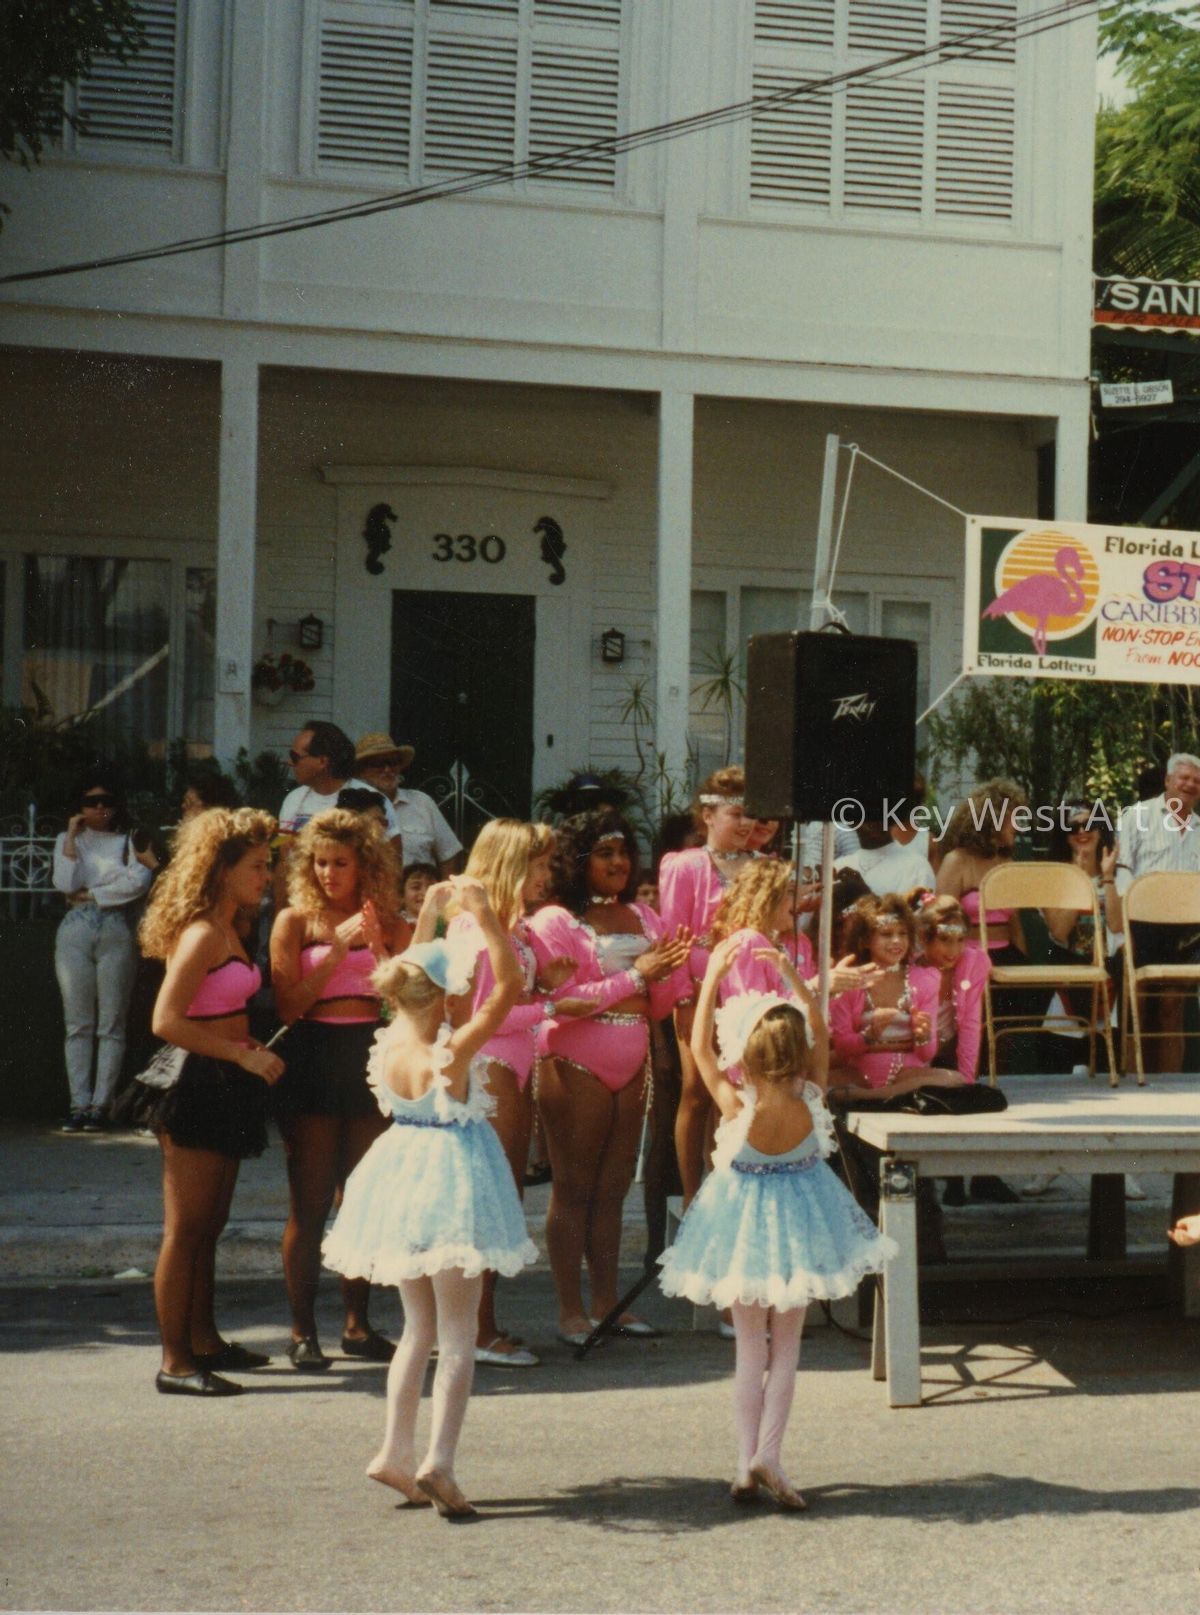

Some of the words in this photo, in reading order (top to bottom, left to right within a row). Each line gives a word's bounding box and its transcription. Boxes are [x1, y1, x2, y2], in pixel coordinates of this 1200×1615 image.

[432, 533, 507, 564] 330
[1104, 535, 1184, 558] Florida
[977, 654, 1032, 669] Florida
[1038, 657, 1096, 676] Lottery
[1126, 648, 1162, 665] From
